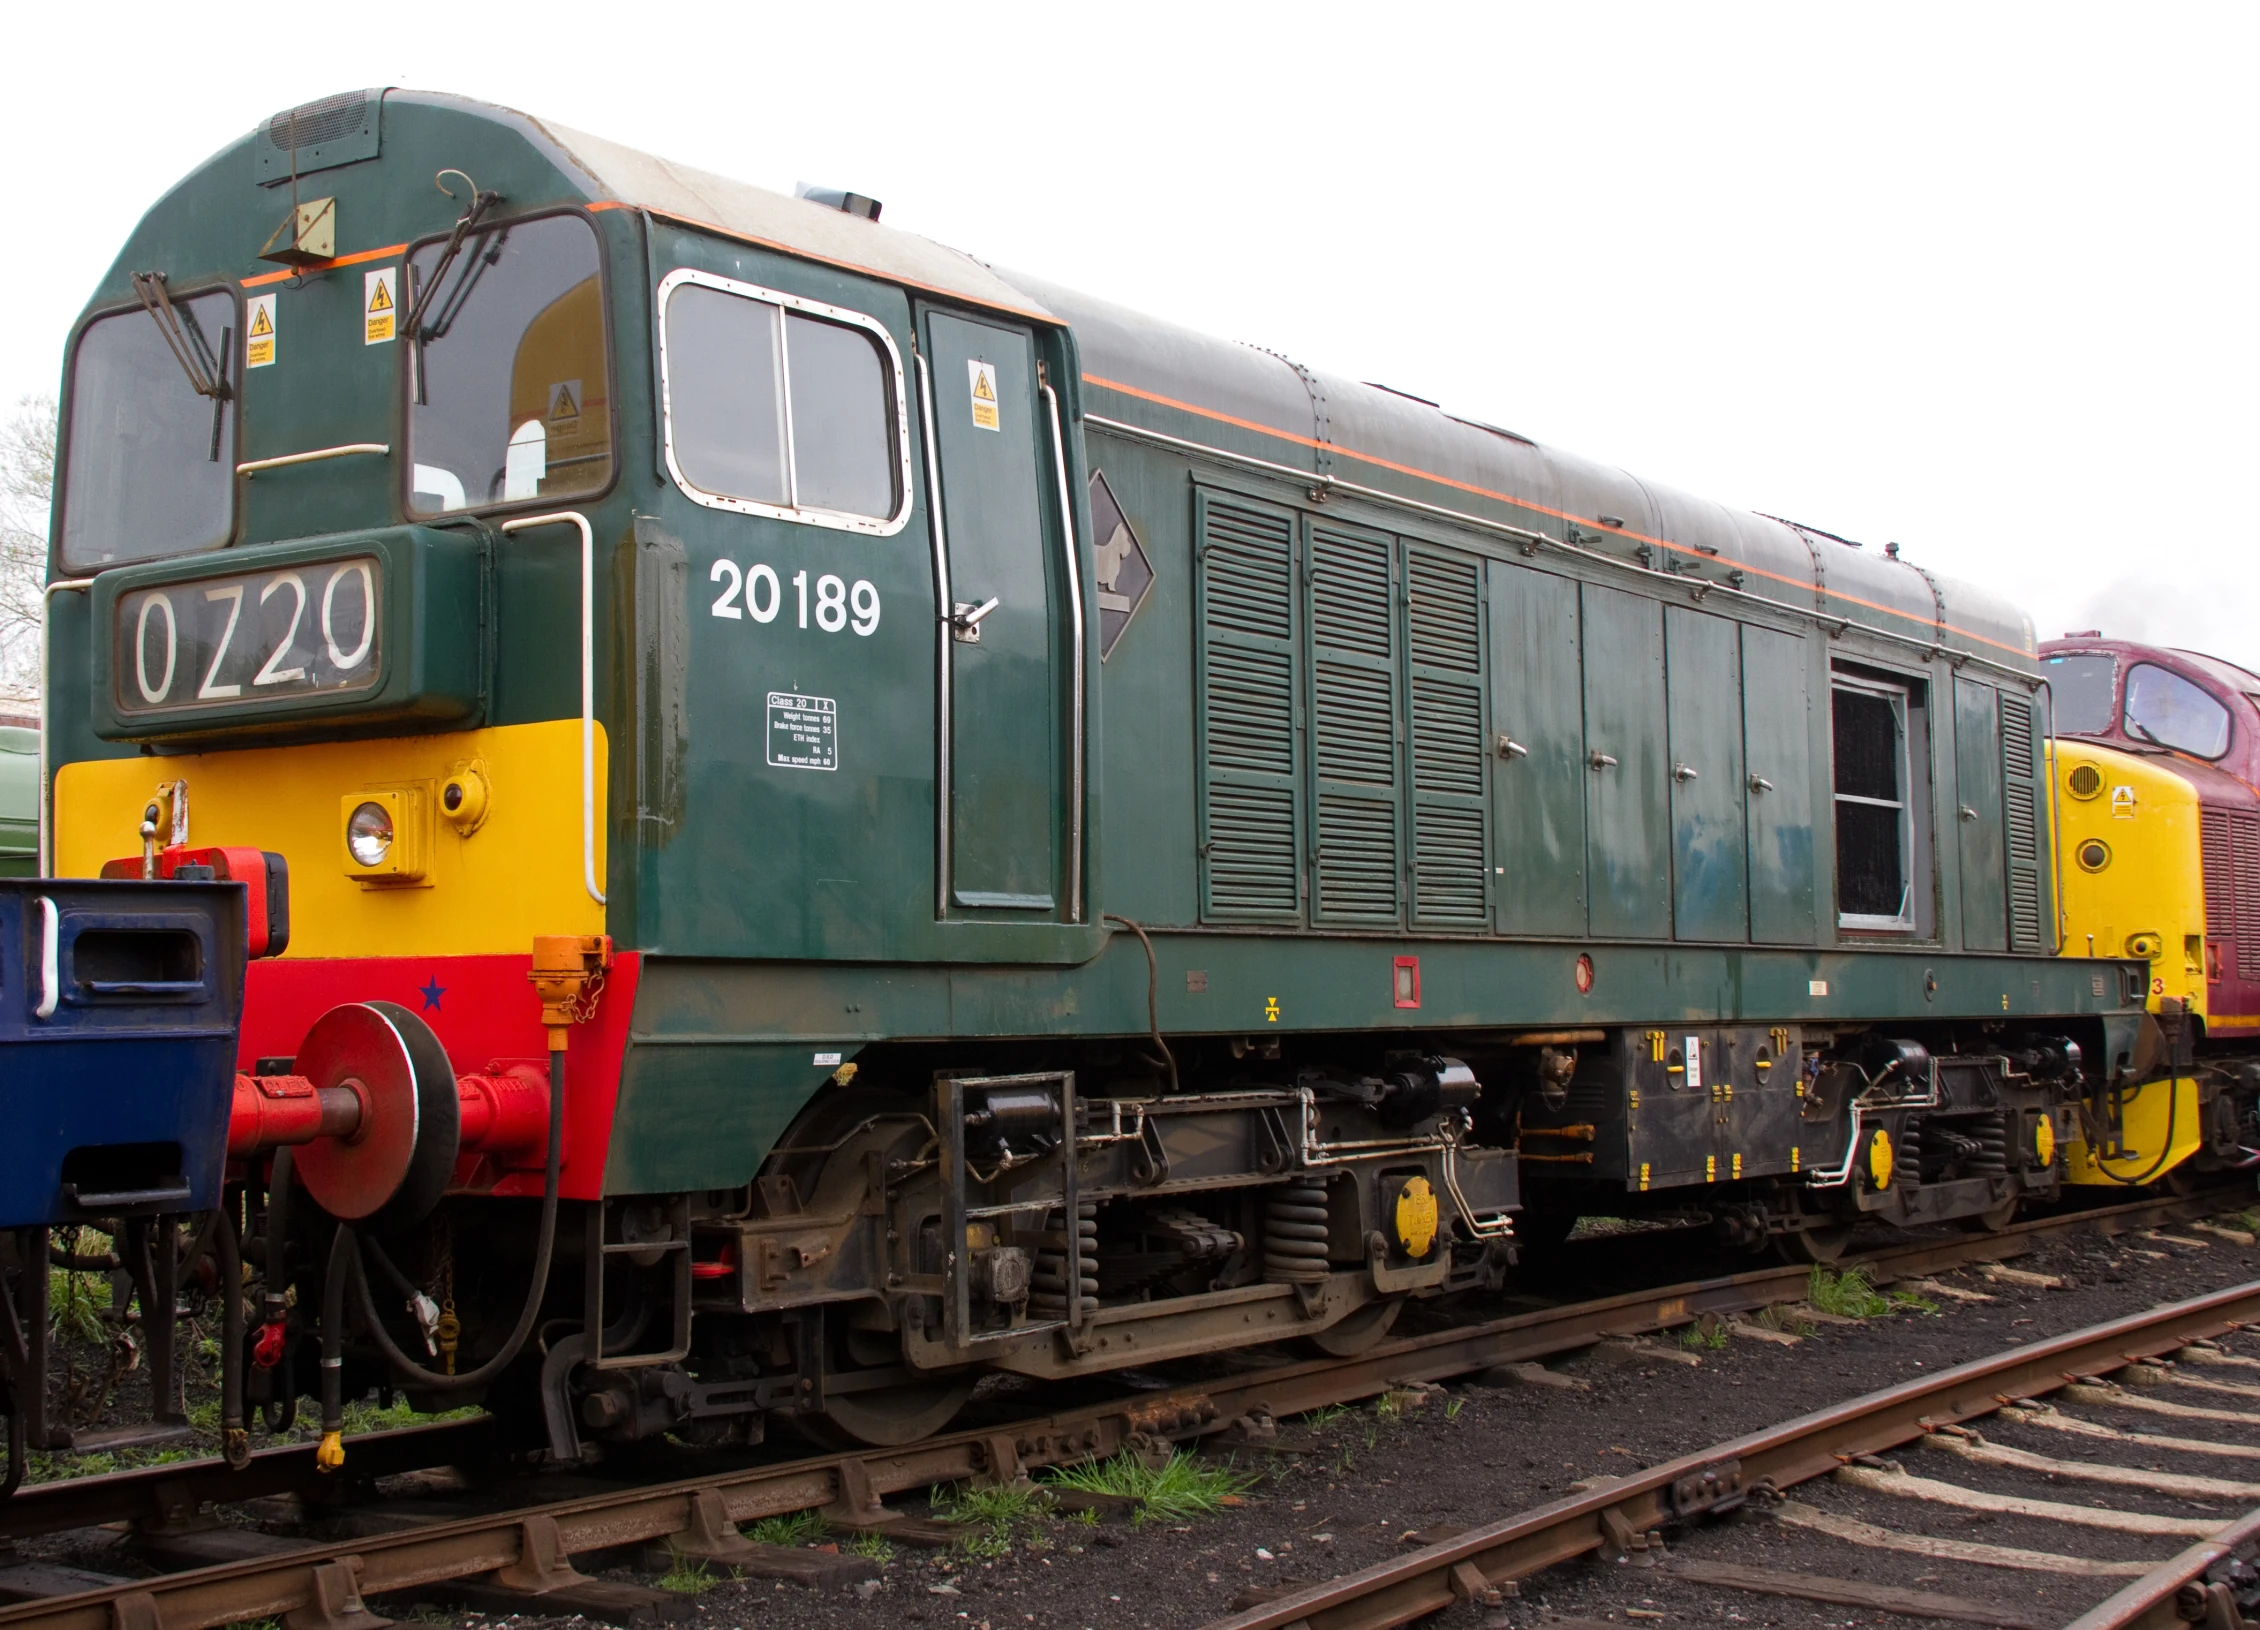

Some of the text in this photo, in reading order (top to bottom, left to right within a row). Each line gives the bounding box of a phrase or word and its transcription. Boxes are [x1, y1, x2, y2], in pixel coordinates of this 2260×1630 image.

[368, 317, 389, 326] Danger
[249, 342, 269, 351] Danger
[771, 695, 829, 711] Class 20 X
[783, 711, 831, 724] Weight tonnes 69
[774, 720, 832, 734] Brake force tonnes 35
[793, 733, 821, 744] ETH index
[812, 746, 832, 755] RA 5
[777, 753, 790, 762] Max
[791, 756, 808, 764] speed
[809, 757, 821, 766] mph
[2152, 977, 2164, 995] 3
